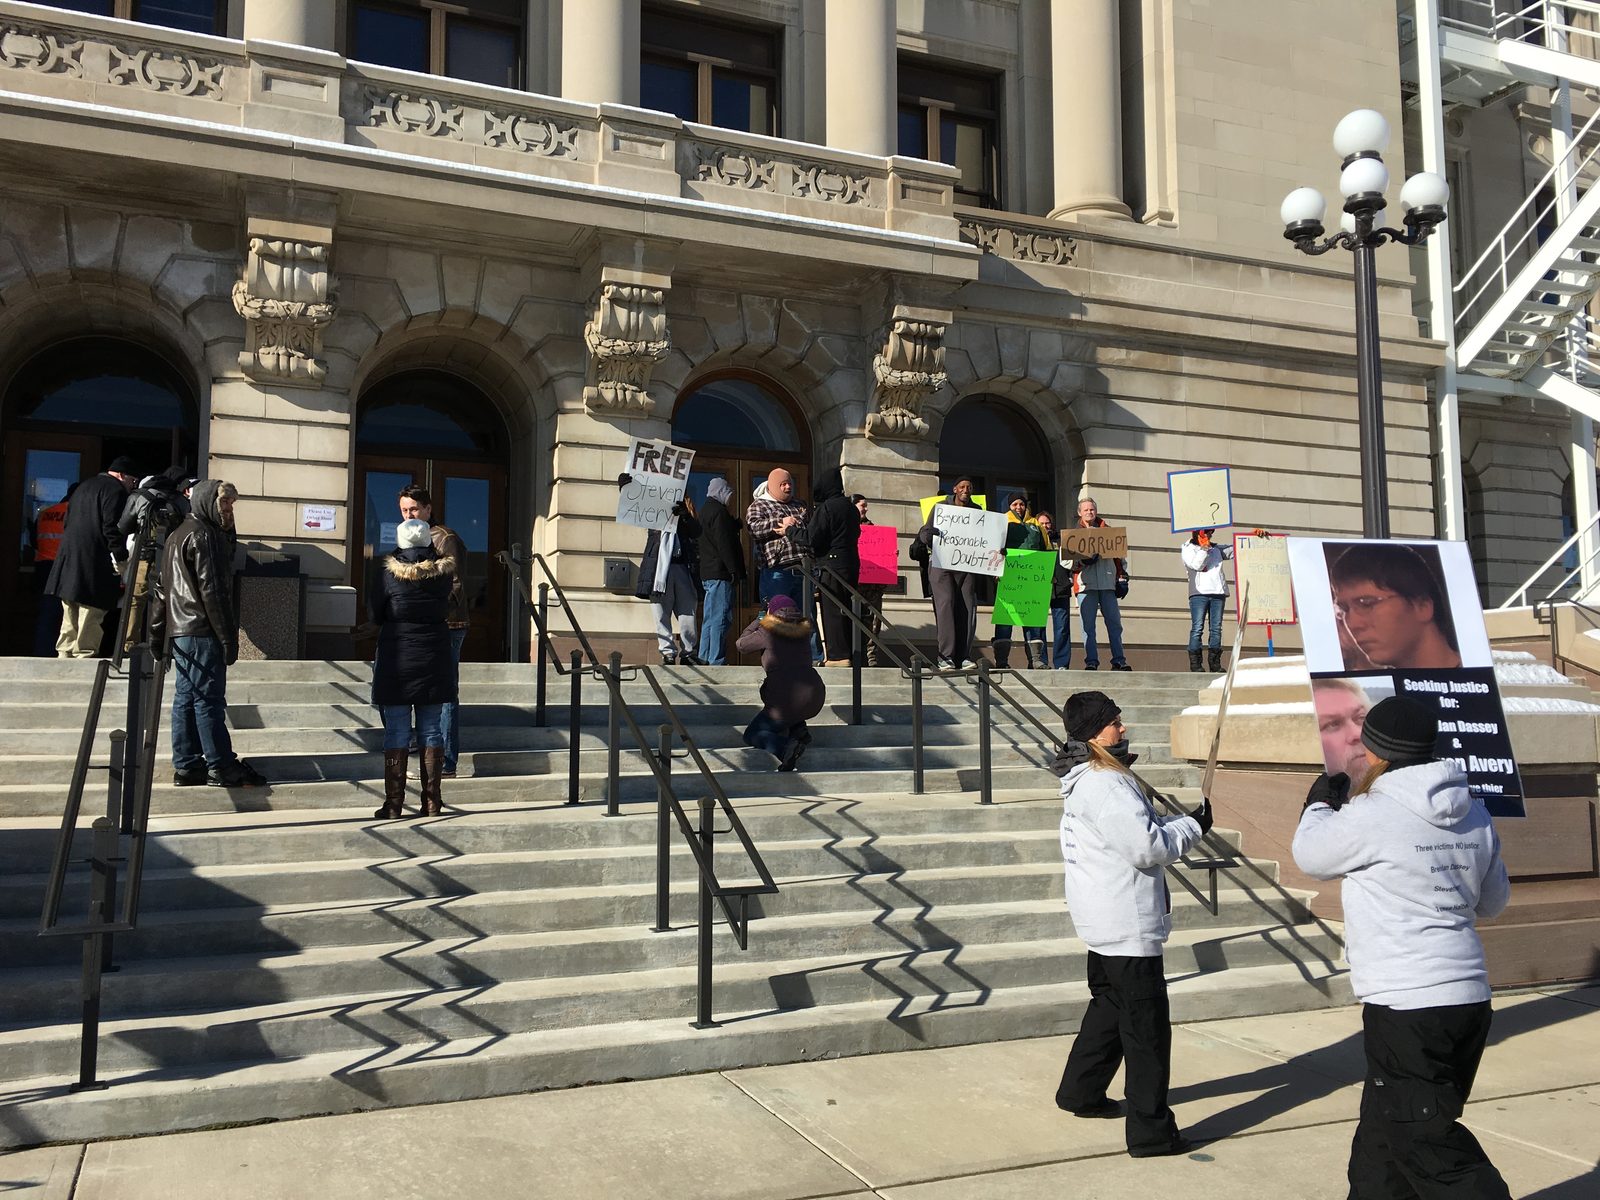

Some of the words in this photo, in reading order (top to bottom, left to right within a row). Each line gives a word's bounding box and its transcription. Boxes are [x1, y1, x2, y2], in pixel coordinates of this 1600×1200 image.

[632, 441, 694, 480] FREE
[627, 474, 682, 502] Steven
[623, 502, 673, 530] Avery
[976, 514, 985, 527] A
[1210, 503, 1219, 525] ?
[939, 530, 988, 549] Reasonable
[1034, 573, 1046, 582] DA
[1404, 679, 1449, 693] Seeking
[1449, 681, 1489, 693] Justice
[1440, 696, 1460, 708] for:
[1457, 720, 1498, 734] Dassey
[1452, 737, 1462, 749] &
[1469, 755, 1514, 774] Avery
[1455, 842, 1463, 850] NO
